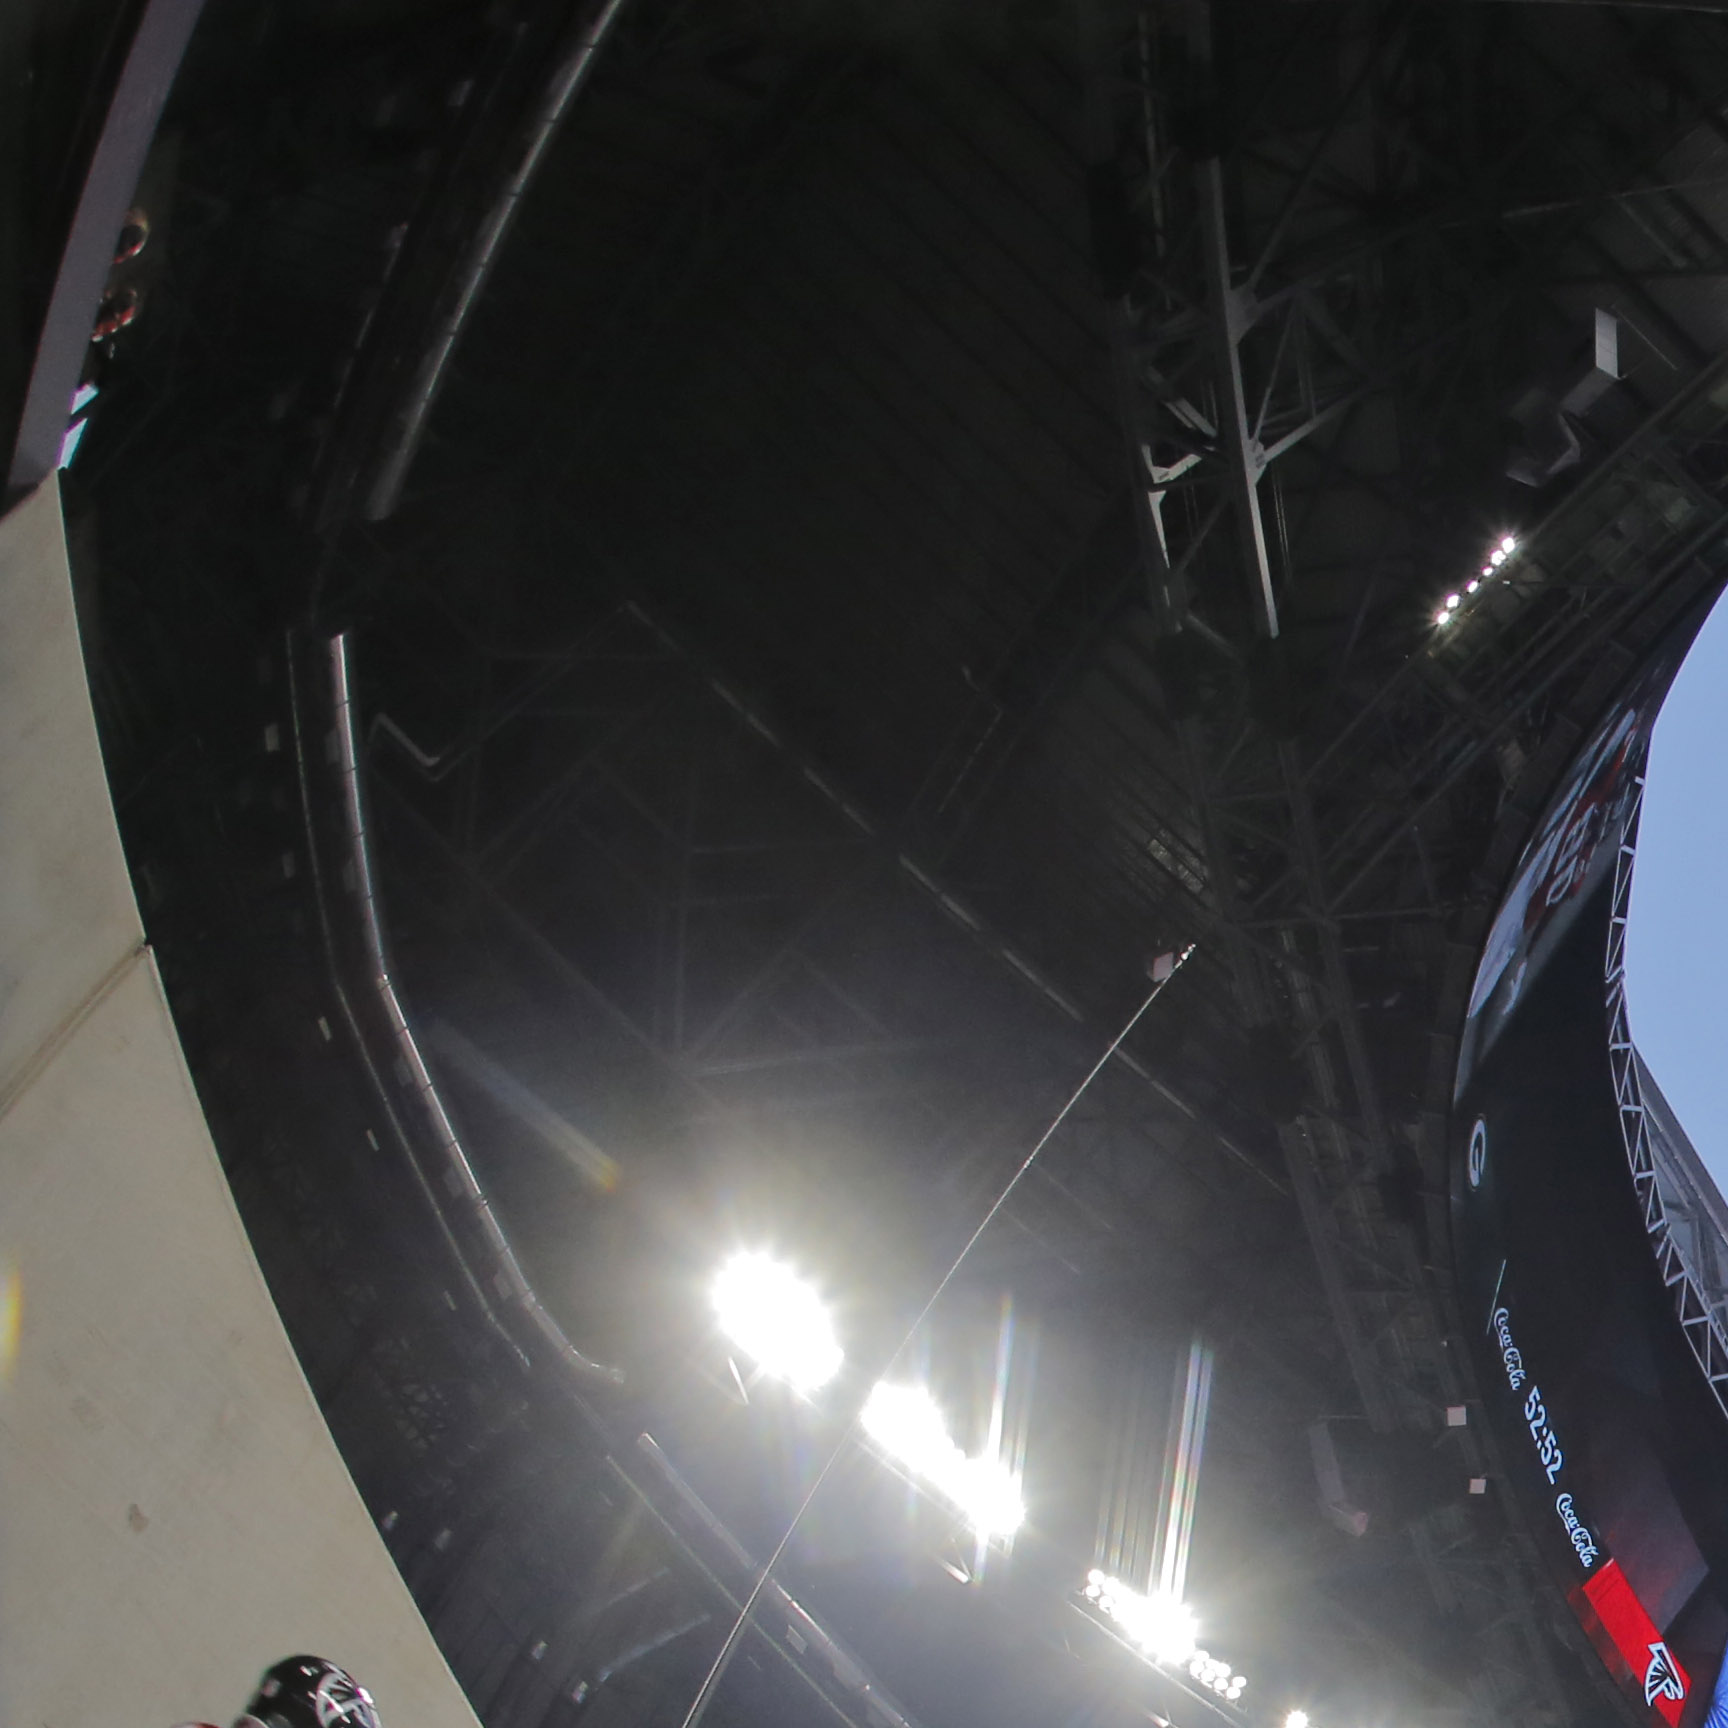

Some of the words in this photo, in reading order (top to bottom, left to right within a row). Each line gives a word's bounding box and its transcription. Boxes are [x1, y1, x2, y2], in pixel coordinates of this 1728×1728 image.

[1493, 1307, 1526, 1391] Coca-Cola
[1524, 1385, 1563, 1485] 52:52
[1556, 1493, 1599, 1568] Coca-Cola
